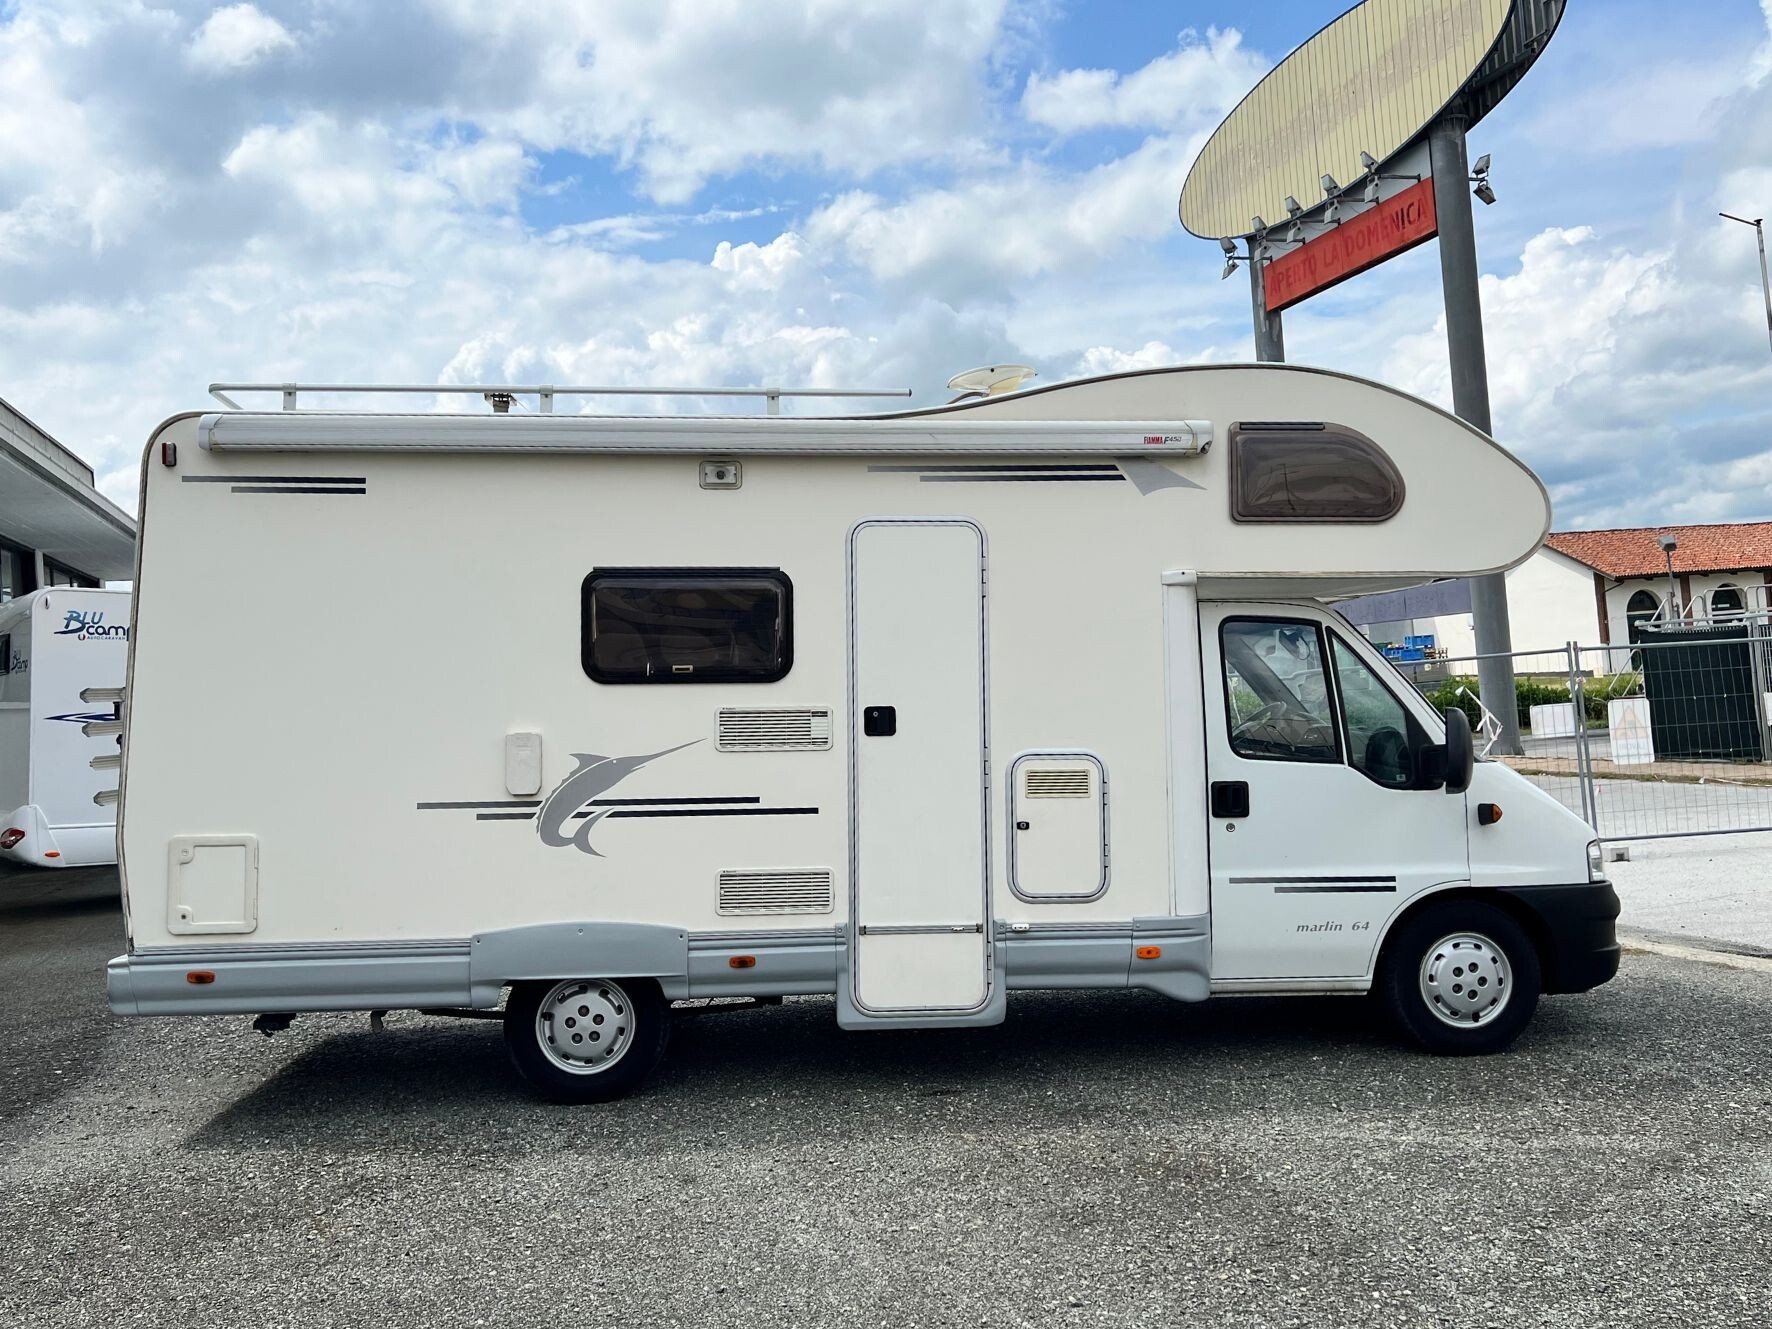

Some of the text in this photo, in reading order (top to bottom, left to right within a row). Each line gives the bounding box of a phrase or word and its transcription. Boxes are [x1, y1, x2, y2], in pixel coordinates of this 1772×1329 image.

[1323, 241, 1341, 268] LA
[1344, 197, 1428, 258] DOMENICA
[58, 610, 104, 633] BLU
[1296, 921, 1370, 932] marlin 64
